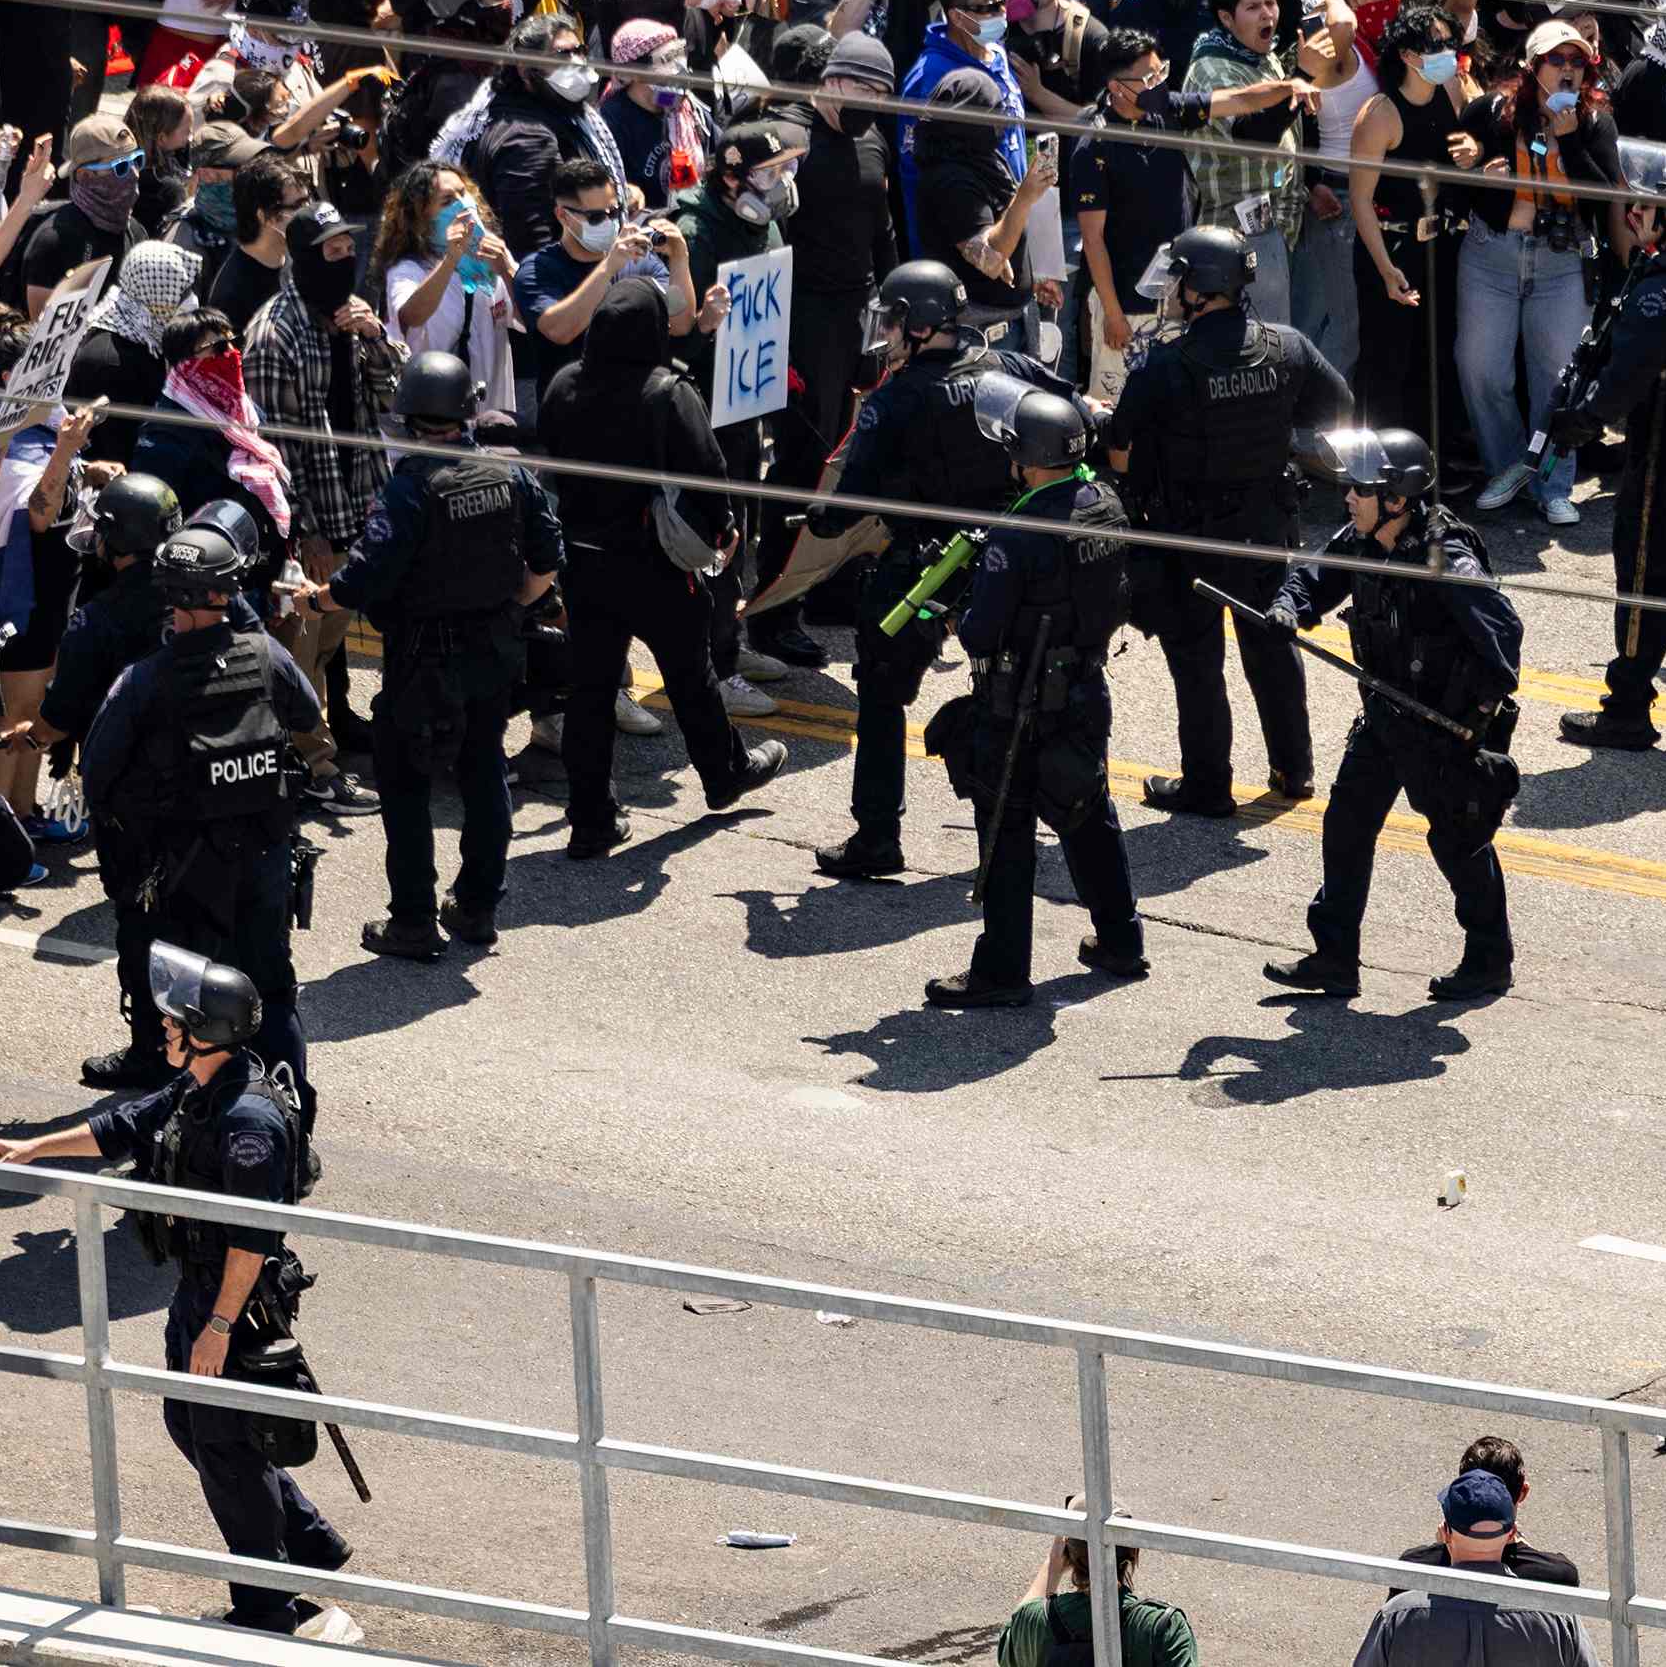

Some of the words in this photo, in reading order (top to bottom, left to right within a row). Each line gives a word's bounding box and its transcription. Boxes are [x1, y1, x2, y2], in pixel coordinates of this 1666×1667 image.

[726, 268, 783, 333] FUCK
[727, 339, 778, 408] ICE
[1207, 368, 1278, 400] DELGADILLO
[448, 483, 513, 521] FREEMAN
[210, 750, 278, 786] POLICE
